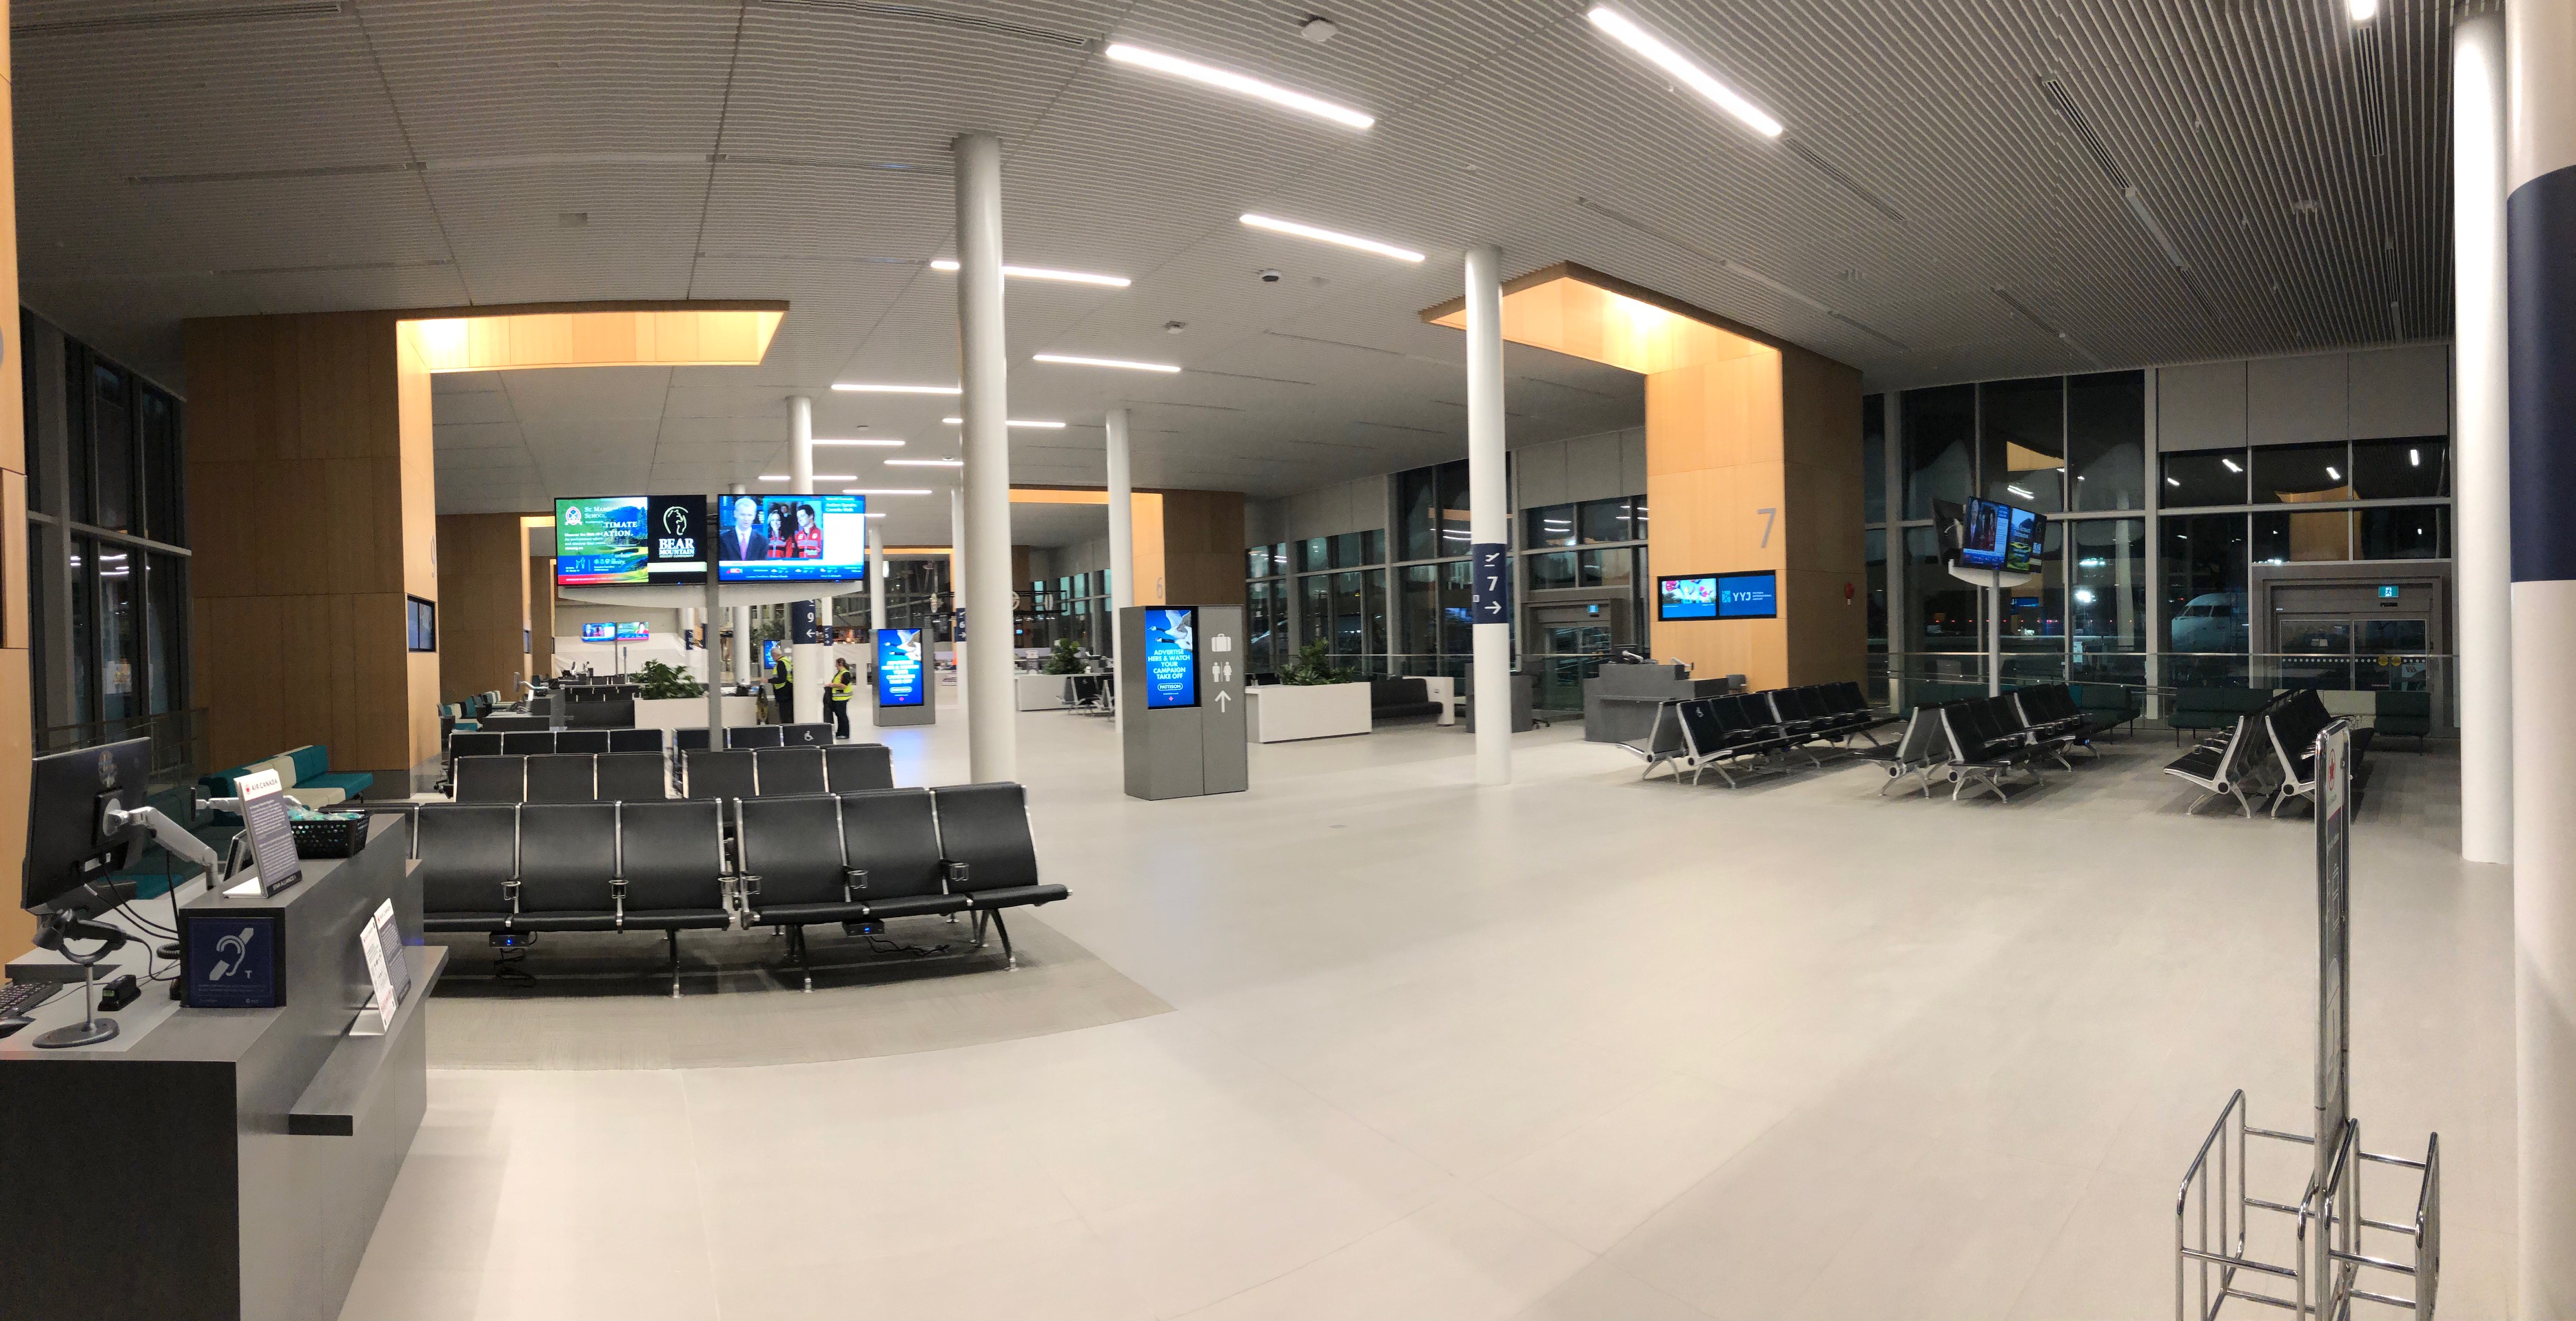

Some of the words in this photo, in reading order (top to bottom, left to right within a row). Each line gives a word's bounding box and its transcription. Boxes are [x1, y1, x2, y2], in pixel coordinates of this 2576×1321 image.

[1757, 507, 1776, 549] 7
[659, 538, 695, 549] BEAR
[1156, 577, 1163, 599] 6
[1486, 576, 1498, 591] 7
[1732, 591, 1751, 602] YYJ
[807, 612, 815, 623] 9
[260, 779, 278, 789] CANADA
[245, 970, 252, 979] T
